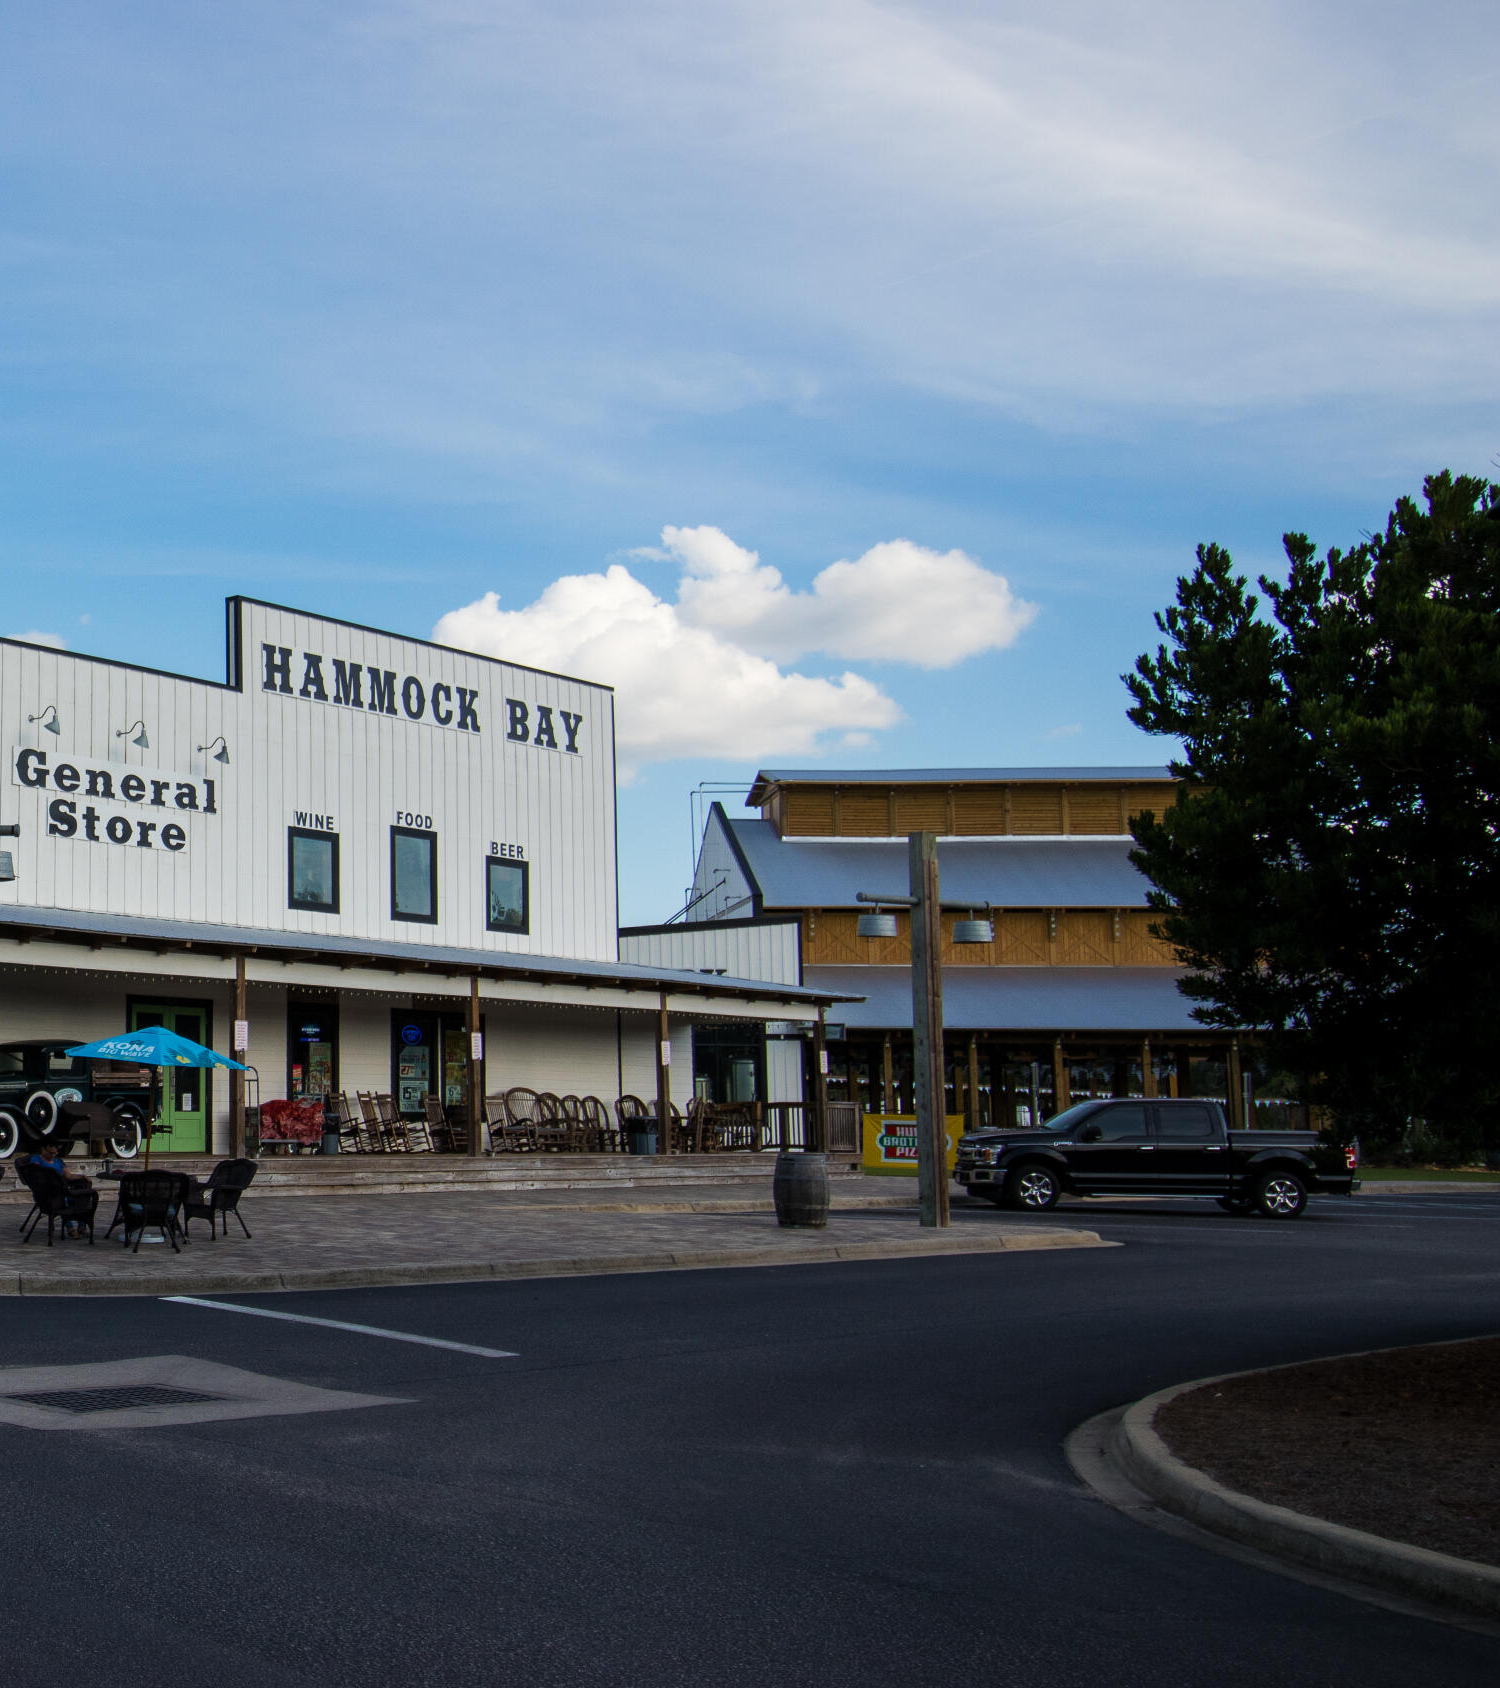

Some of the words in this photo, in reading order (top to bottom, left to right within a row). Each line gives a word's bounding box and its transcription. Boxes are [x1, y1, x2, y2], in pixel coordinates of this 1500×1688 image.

[262, 643, 481, 733] HAMMOCK
[506, 697, 583, 754] BAY
[15, 748, 217, 814] General
[48, 798, 187, 851] Store
[295, 811, 335, 831] WINE
[396, 811, 433, 829] FOOD
[490, 841, 525, 859] BEER
[97, 1047, 119, 1055] BIG
[120, 1050, 151, 1058] WAVE
[103, 1041, 156, 1053] KONA
[896, 1127, 917, 1136] HU
[883, 1137, 917, 1146] BROT
[896, 1147, 917, 1157] PIZ
